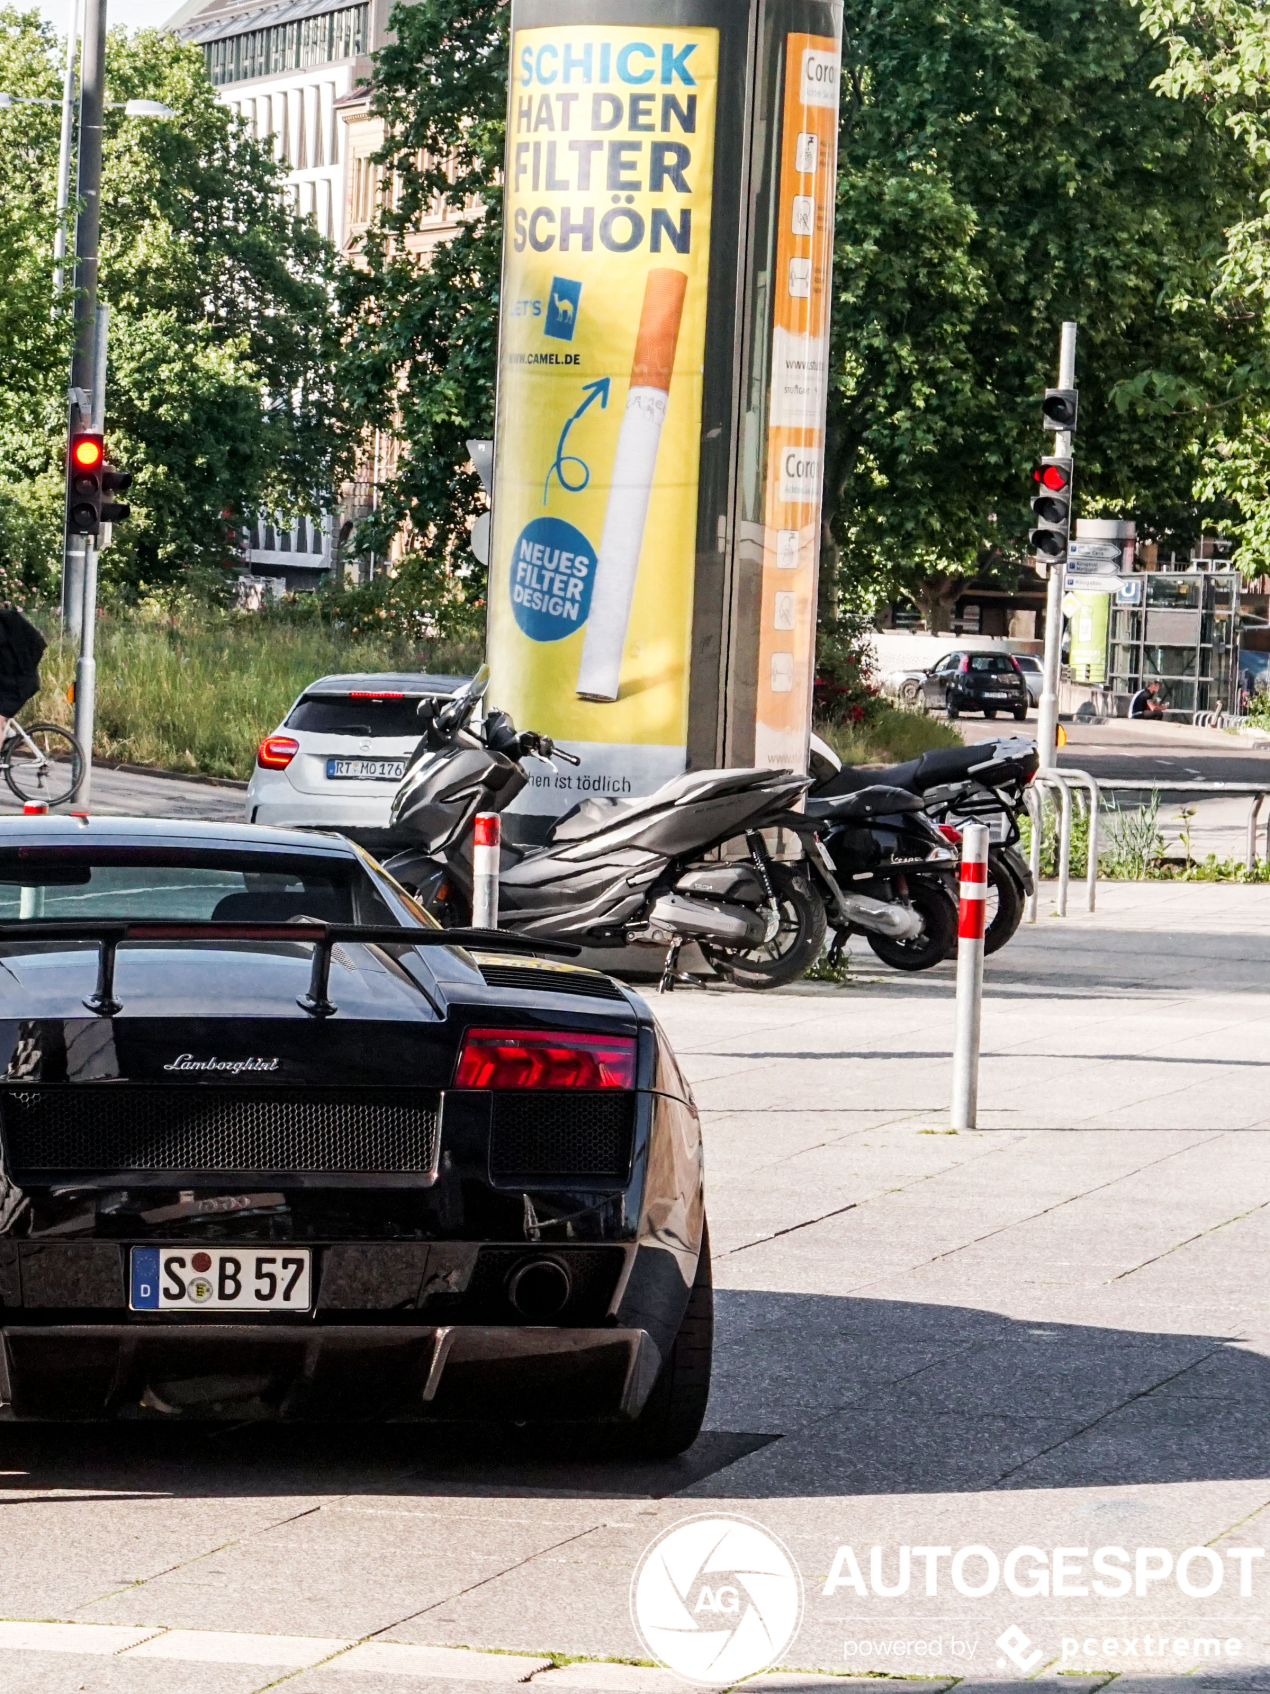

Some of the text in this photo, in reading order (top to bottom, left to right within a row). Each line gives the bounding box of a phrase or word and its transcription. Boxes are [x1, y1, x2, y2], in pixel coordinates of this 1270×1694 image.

[520, 42, 698, 86] SCHICK
[517, 93, 697, 133] HAT DEN
[514, 140, 693, 193] FILTER
[513, 194, 691, 255] SCHÖN
[520, 539, 589, 577] NEUES
[516, 561, 584, 601] FILTER
[513, 584, 580, 621] DESIGN
[336, 761, 403, 777] RT MO 176
[554, 773, 572, 789] ist
[576, 775, 631, 793] tödlich
[163, 1053, 279, 1074] Lamborghini
[140, 1285, 151, 1297] D
[163, 1256, 305, 1302] S B 57
